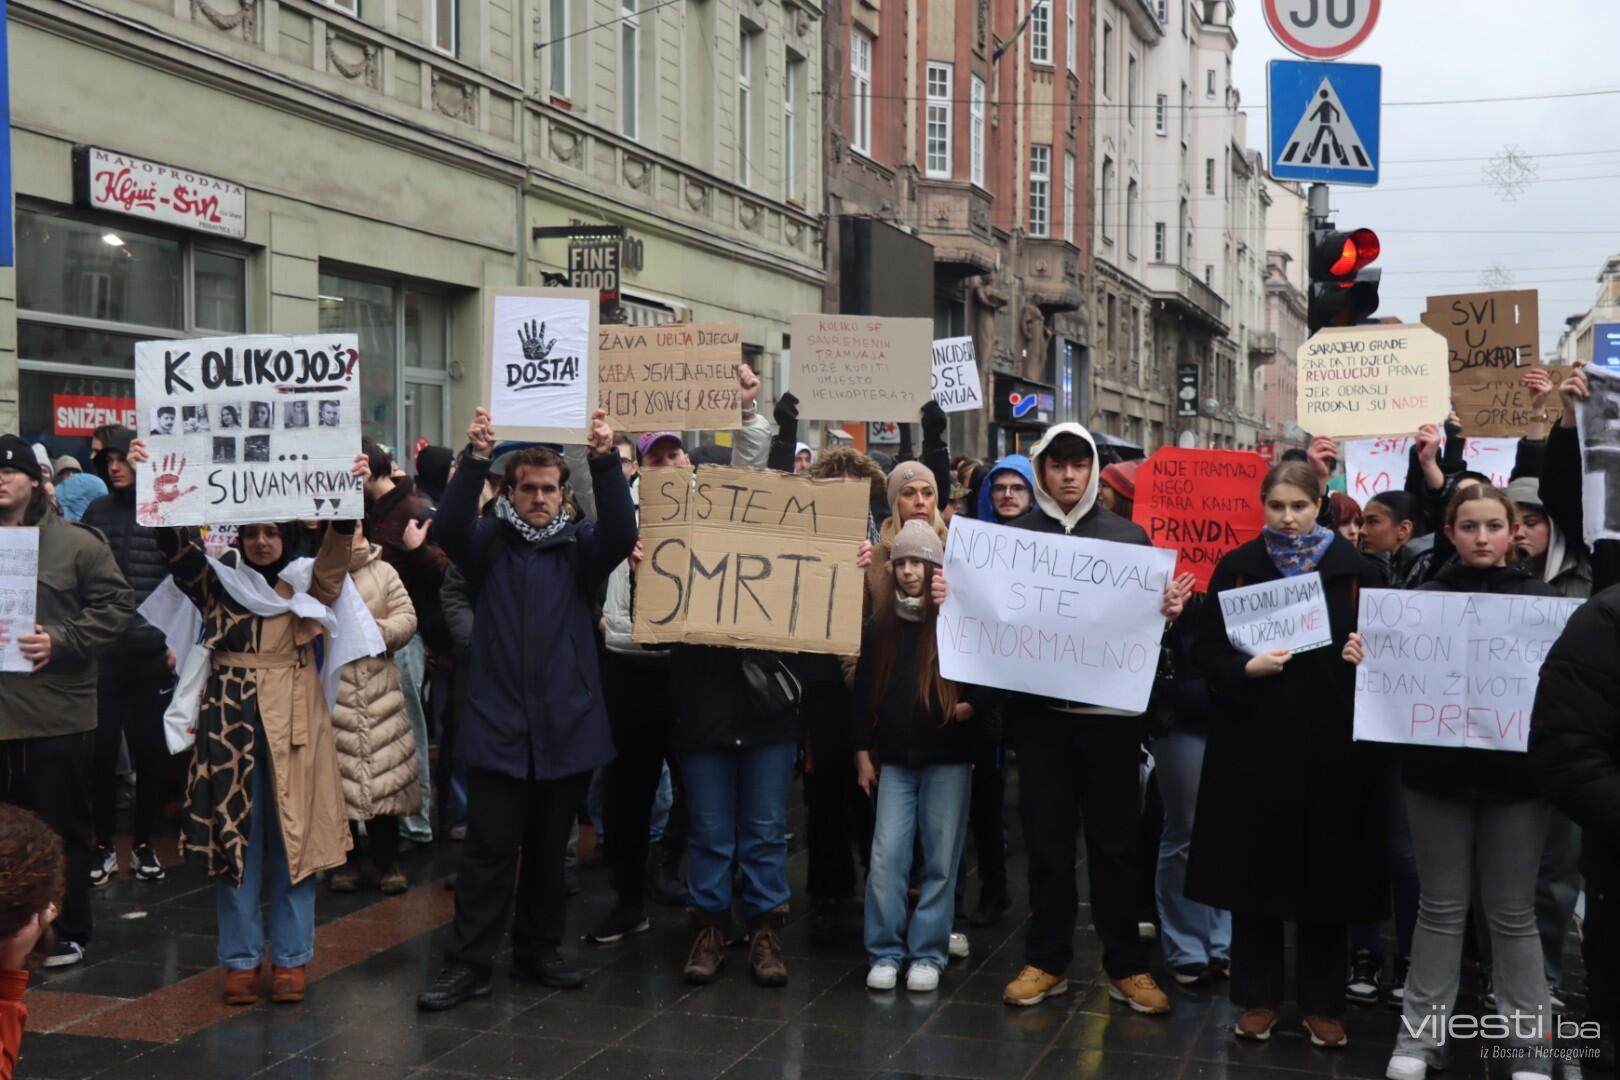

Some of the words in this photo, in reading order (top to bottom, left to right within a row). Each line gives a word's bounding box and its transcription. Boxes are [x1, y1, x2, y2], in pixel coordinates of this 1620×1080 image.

[95, 151, 242, 195] MALOPRODAJA
[572, 247, 616, 270] FINE
[571, 270, 616, 291] FOOD
[1451, 298, 1496, 326] SVI
[819, 320, 859, 333] KOLIKO
[868, 322, 883, 333] SE
[656, 331, 693, 346] UBIJA
[807, 336, 891, 349] SAVREMENIH
[1308, 340, 1365, 357] SARAJEVO
[1369, 338, 1408, 350] GRADE
[1465, 329, 1487, 349] U
[816, 349, 886, 361] TRAMVAJA
[1303, 358, 1326, 370] ZAR
[1360, 353, 1400, 367] DJECA
[506, 356, 579, 387] DOSTA!
[801, 361, 837, 374] MOŽE
[941, 365, 966, 388] SE
[1305, 366, 1380, 382] REVOLUCIJU
[1388, 364, 1430, 377] PRAVE
[1305, 387, 1329, 398] JER
[1337, 384, 1388, 397] ODRASLI
[57, 402, 136, 431] SNIŽENJE
[1307, 400, 1360, 414] PRODALI
[1367, 400, 1386, 411] SU
[1391, 397, 1428, 410] NADE
[1153, 460, 1187, 477] NIJE
[1192, 461, 1257, 479] TRAMVAJ
[1152, 479, 1194, 495] NEGO
[660, 481, 818, 535] SISTEM
[1150, 495, 1194, 511] STARA
[1202, 496, 1251, 512] KANTA
[1151, 516, 1240, 545] PRAVDA
[949, 527, 1169, 595] NORMALIZOVALI
[649, 538, 839, 640] SMRTI
[1007, 582, 1079, 618] STE
[1222, 587, 1279, 617] DOMOVINU
[1285, 580, 1320, 605] IMAM
[1366, 592, 1480, 628] DOSTA
[1503, 596, 1580, 626] TIŠIN
[1250, 615, 1296, 646] DRŽAVU
[1301, 607, 1321, 632] NE
[940, 614, 1147, 674] NENORMALNO
[1361, 634, 1451, 662] NAKON
[1467, 637, 1553, 664] TRAGE
[1356, 670, 1426, 696] JEDAN
[1443, 671, 1528, 697] ŽIVOT
[1411, 703, 1523, 741] PREVI
